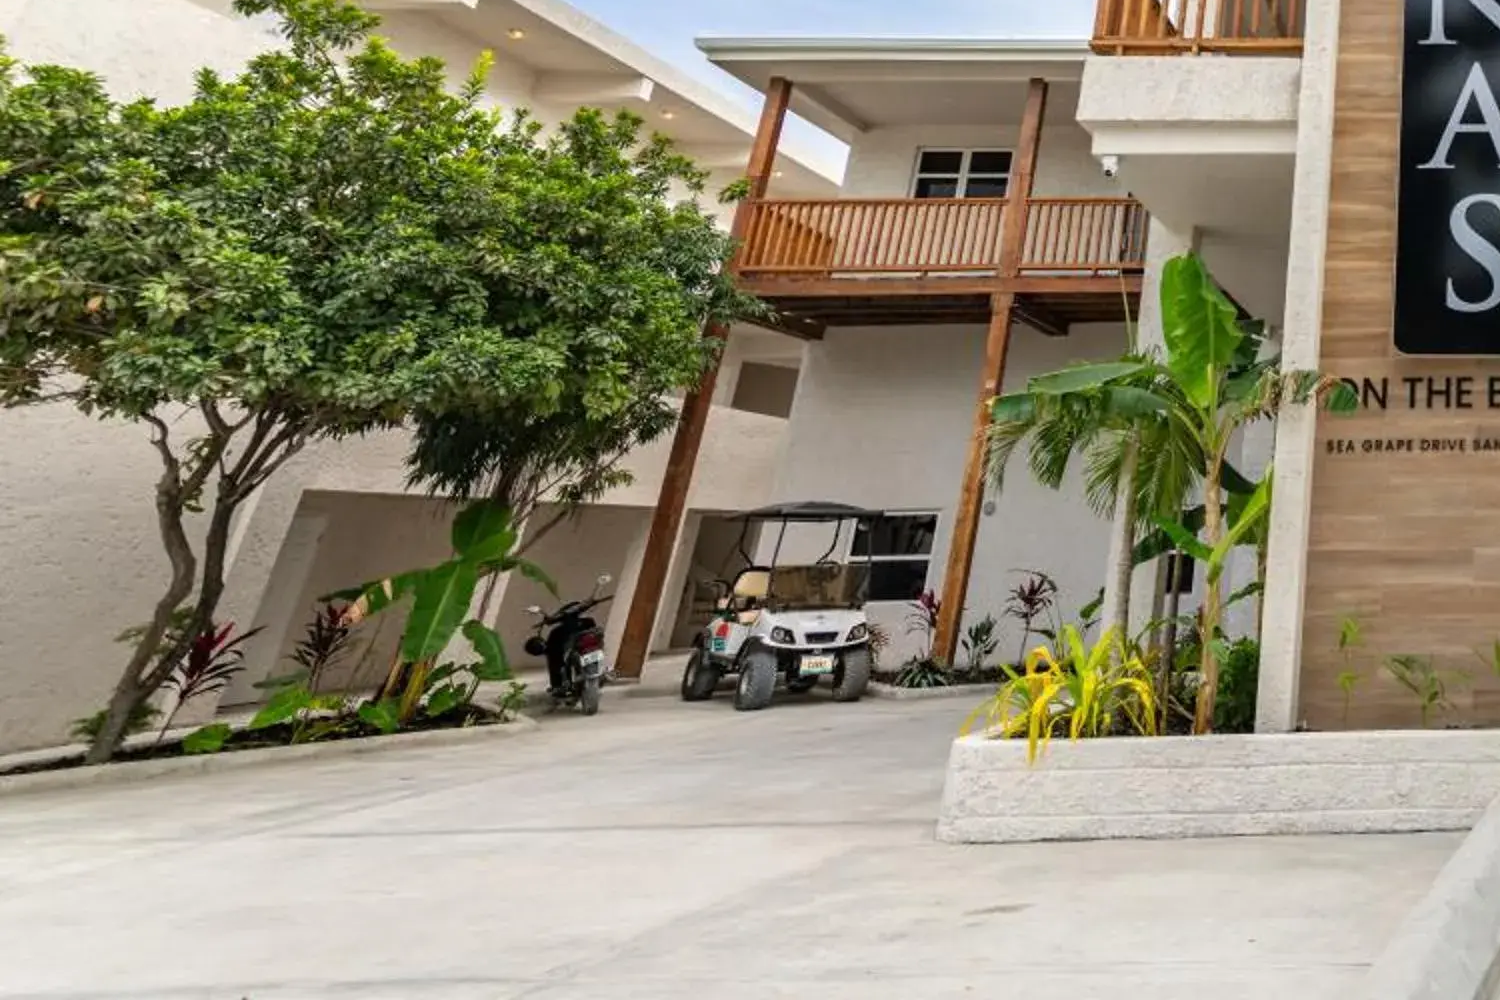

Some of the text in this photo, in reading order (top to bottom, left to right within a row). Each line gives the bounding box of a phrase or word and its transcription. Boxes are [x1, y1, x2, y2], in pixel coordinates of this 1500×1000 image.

[1401, 376, 1473, 410] THE
[1326, 439, 1356, 454] SEA
[1361, 439, 1413, 453] GRAPE
[1420, 438, 1468, 452] DRIVE
